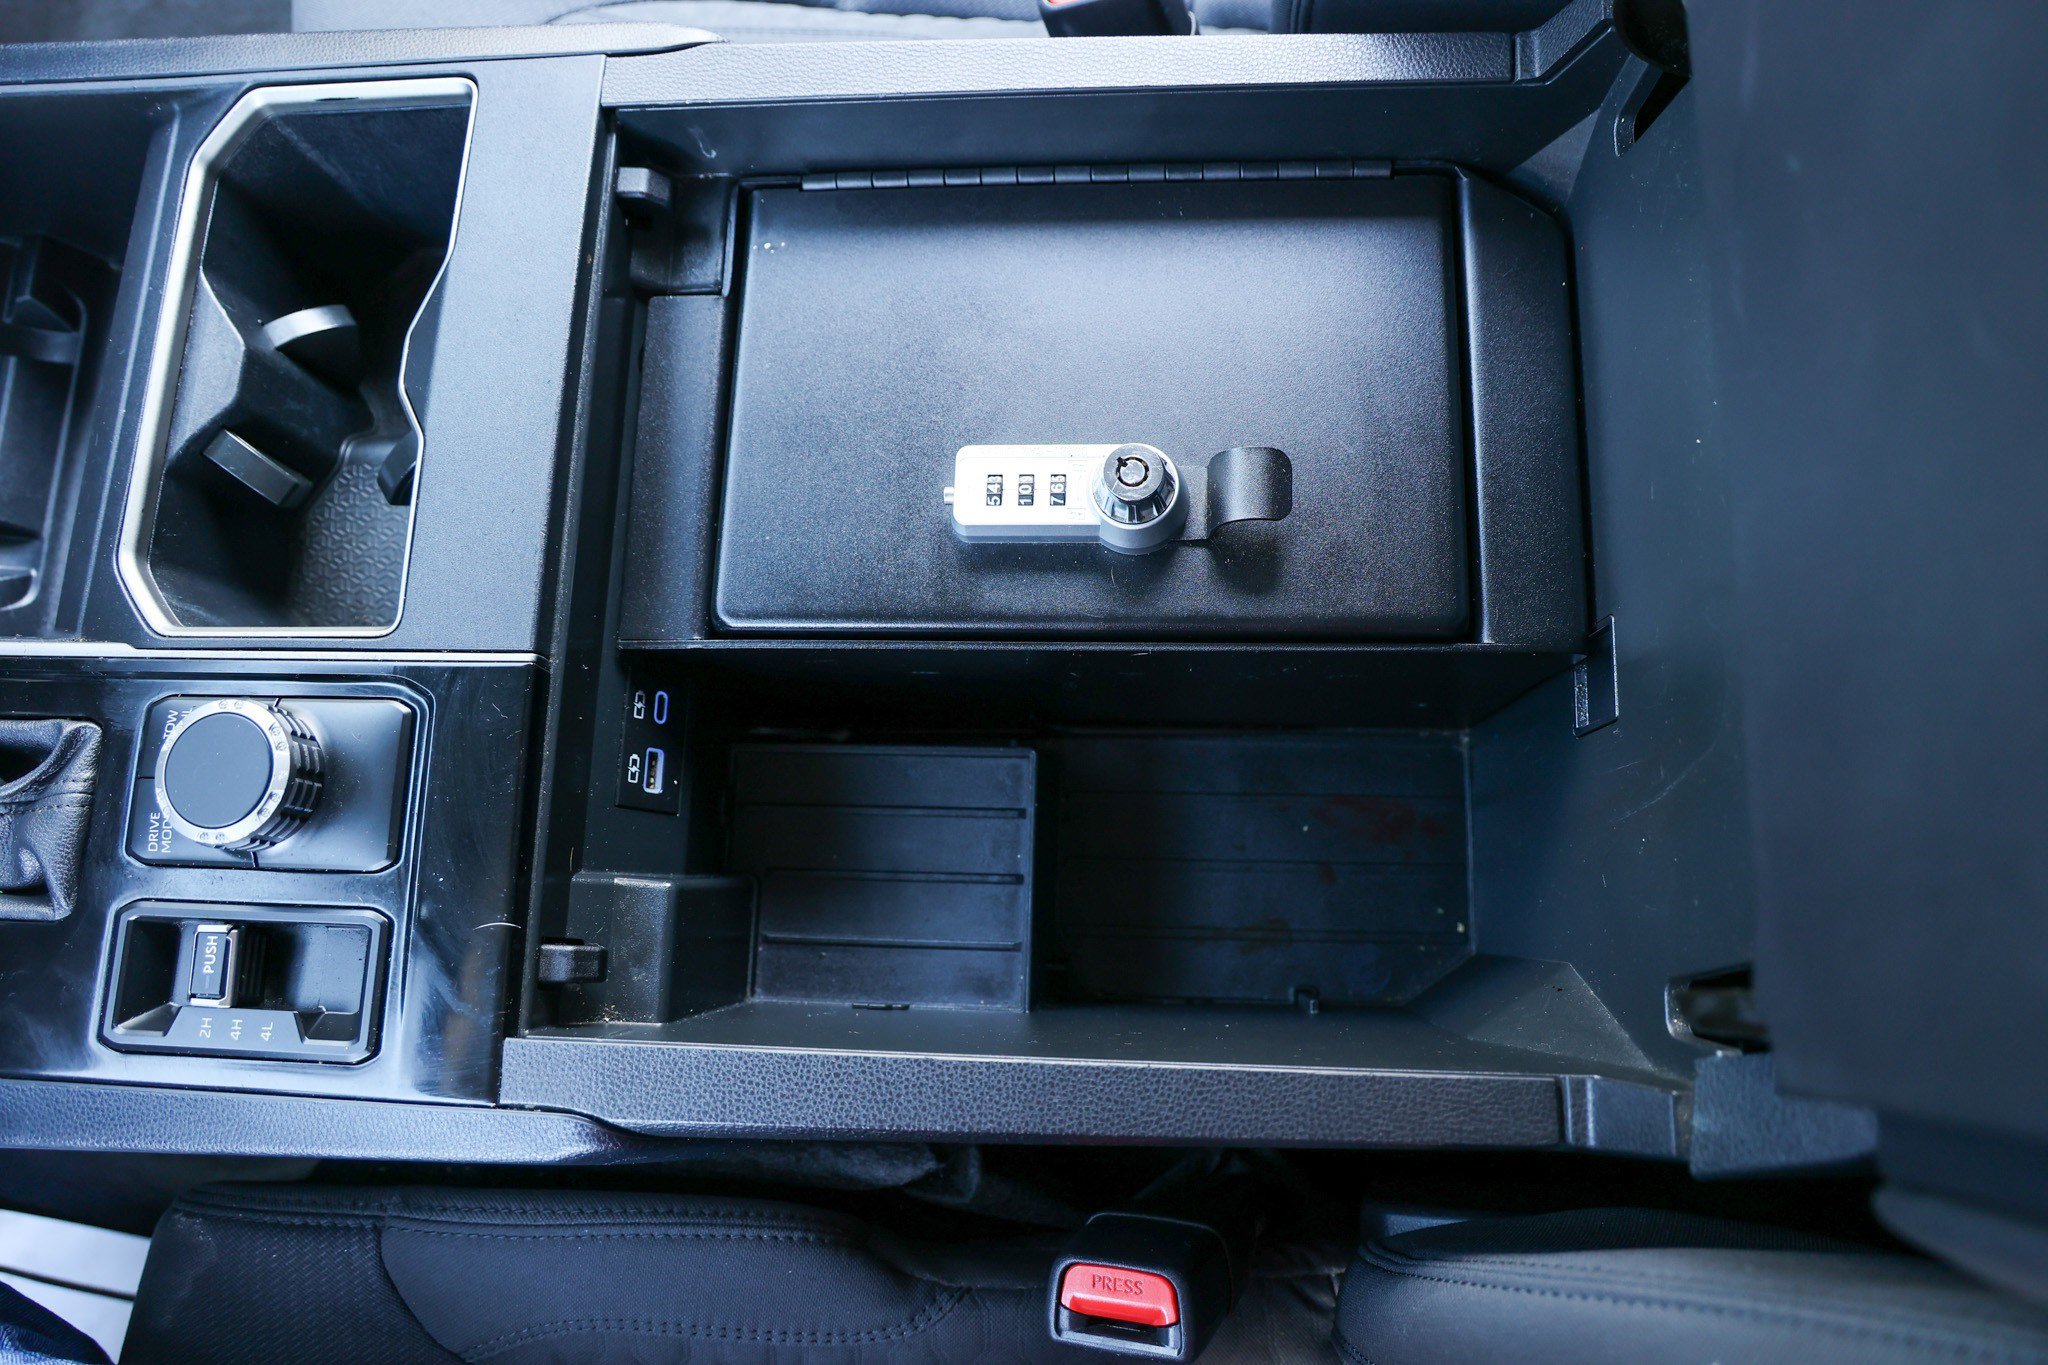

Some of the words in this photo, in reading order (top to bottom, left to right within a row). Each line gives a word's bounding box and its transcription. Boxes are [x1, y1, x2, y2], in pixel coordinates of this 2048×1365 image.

[163, 710, 179, 739] TOW
[148, 812, 161, 852] DRIVE
[162, 818, 173, 853] MOD
[203, 935, 219, 974] PUSH
[199, 1017, 213, 1039] 2H
[230, 1019, 243, 1041] 4H
[260, 1021, 274, 1042] 4L
[1092, 1273, 1144, 1296] PRESS
